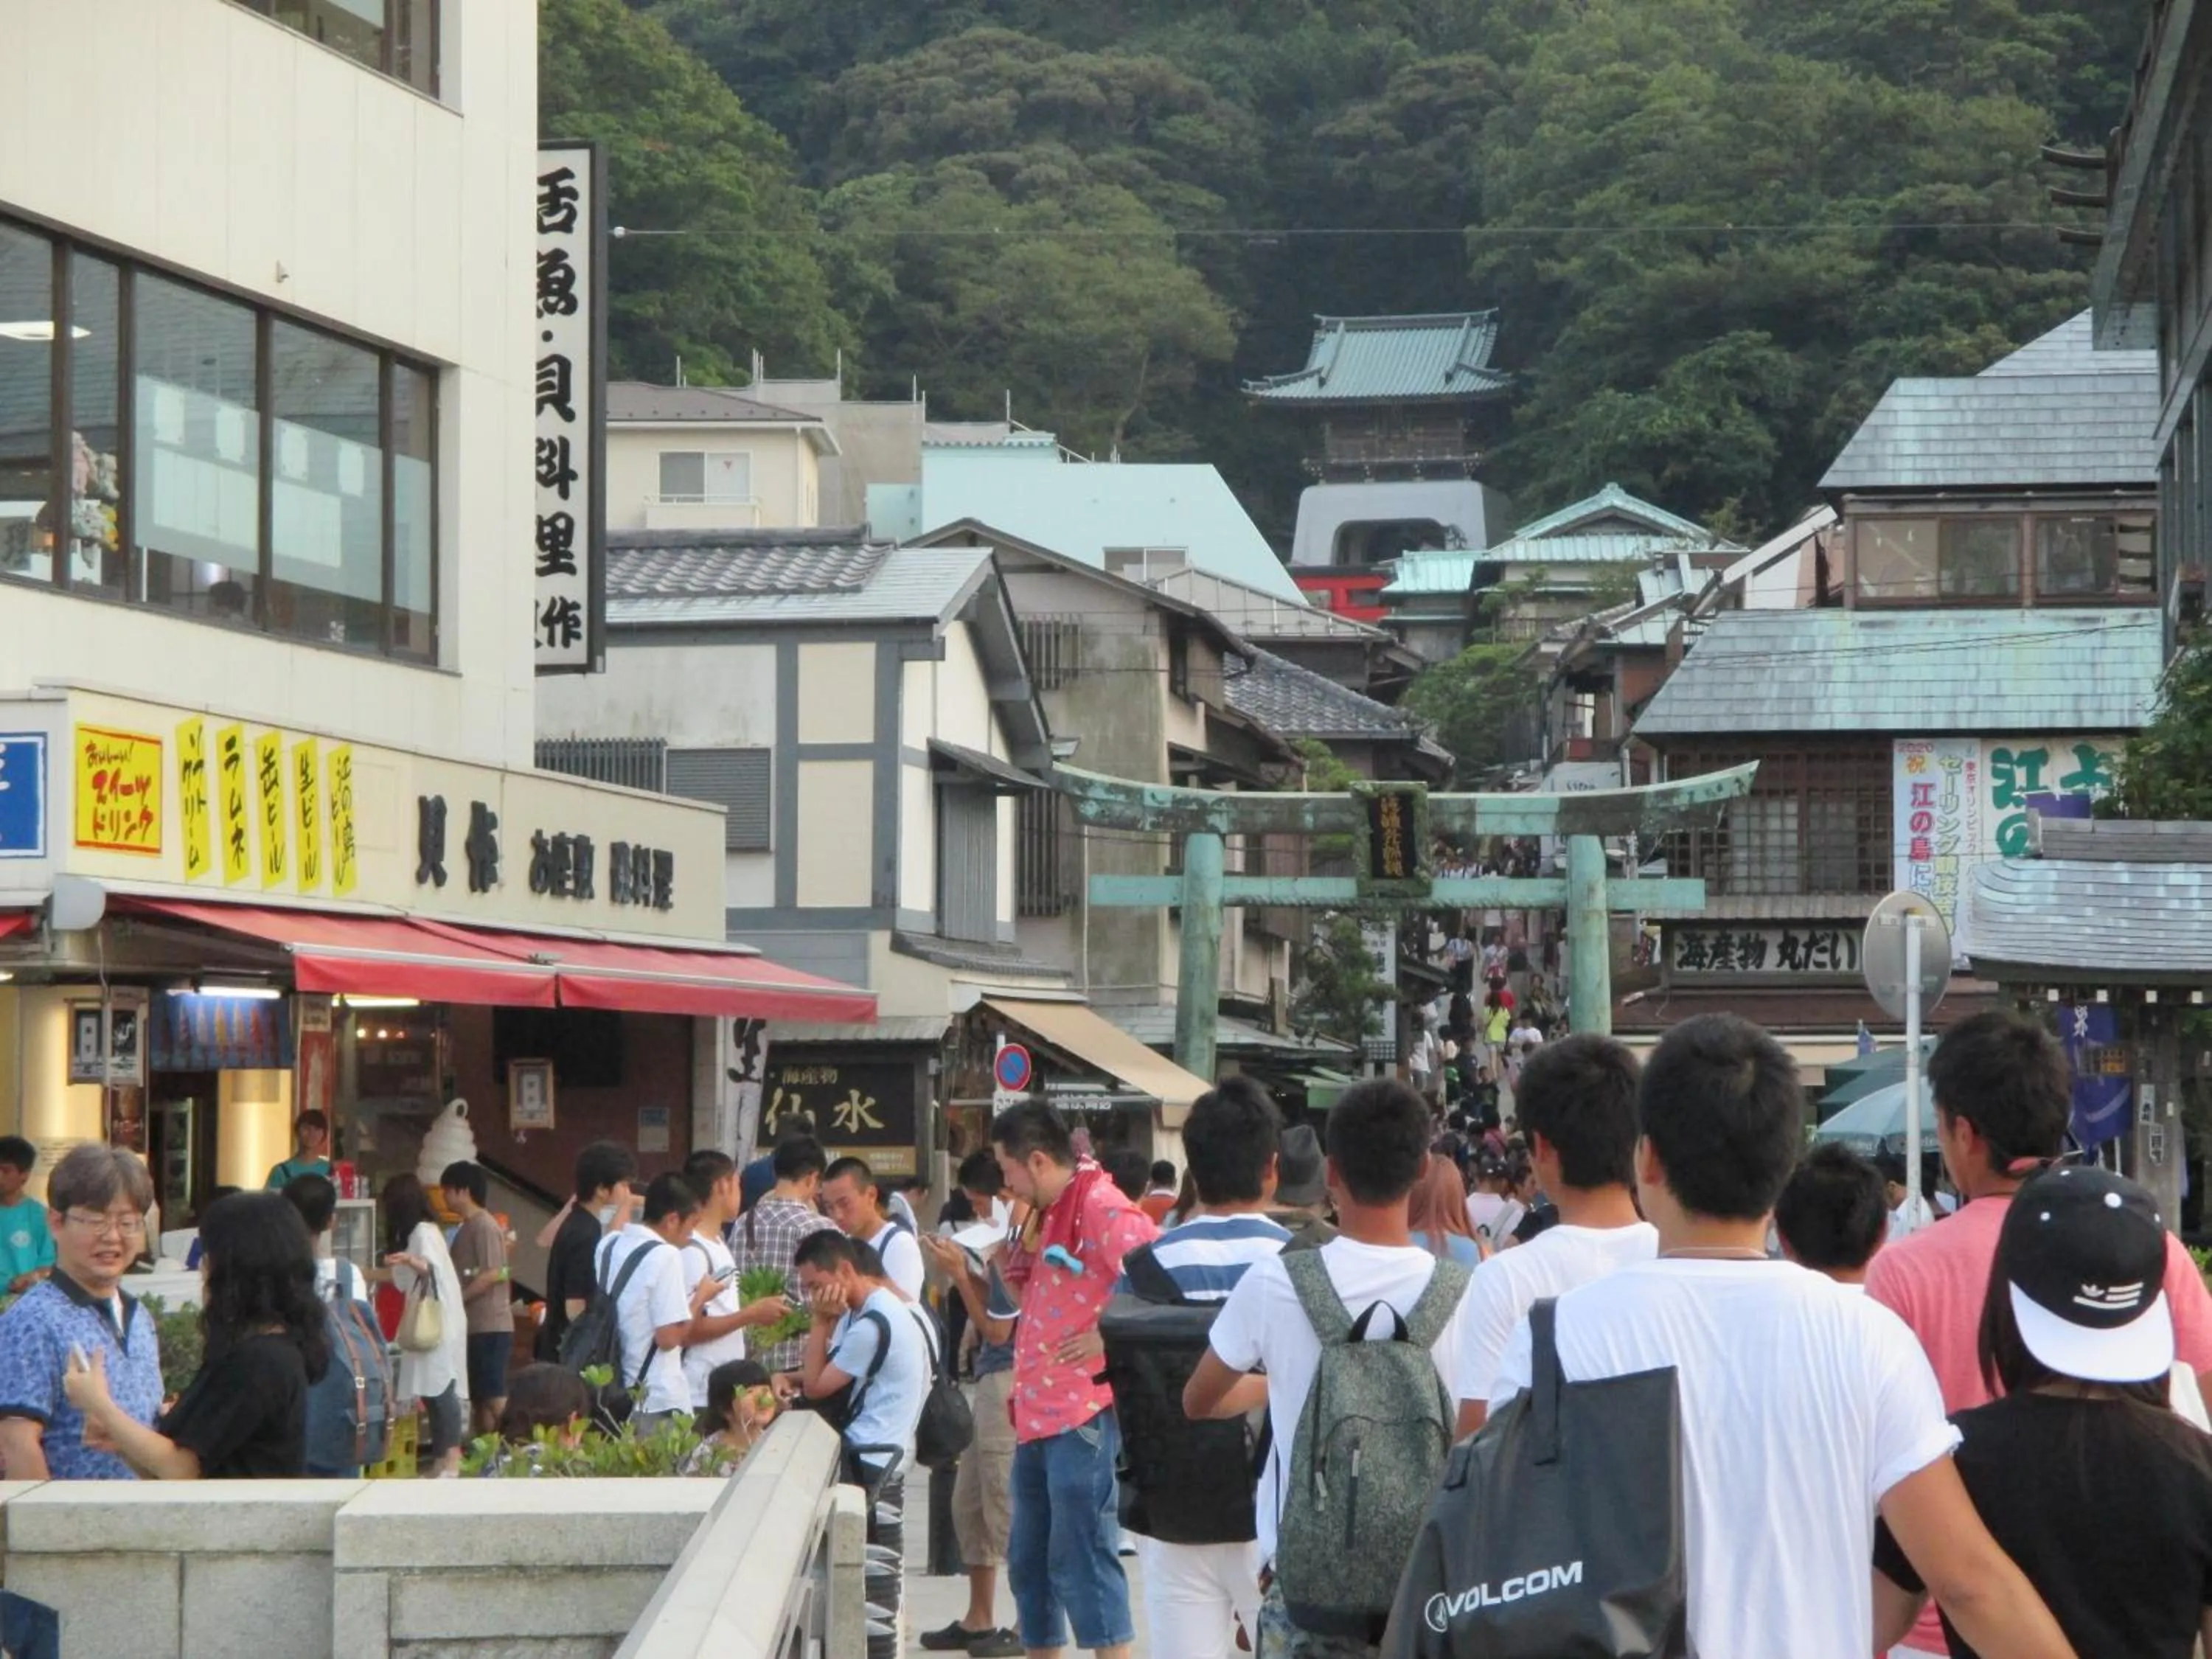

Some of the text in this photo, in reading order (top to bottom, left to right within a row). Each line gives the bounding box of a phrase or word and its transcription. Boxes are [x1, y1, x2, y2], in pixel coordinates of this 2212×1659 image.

[1906, 754, 1927, 774] 祝
[93, 805, 153, 843] ドリンク
[224, 734, 246, 870] ラムネ
[299, 750, 318, 881] 生ビール
[1676, 928, 1857, 971] 海産物 丸だい
[1445, 1561, 1584, 1618] VOLCOM
